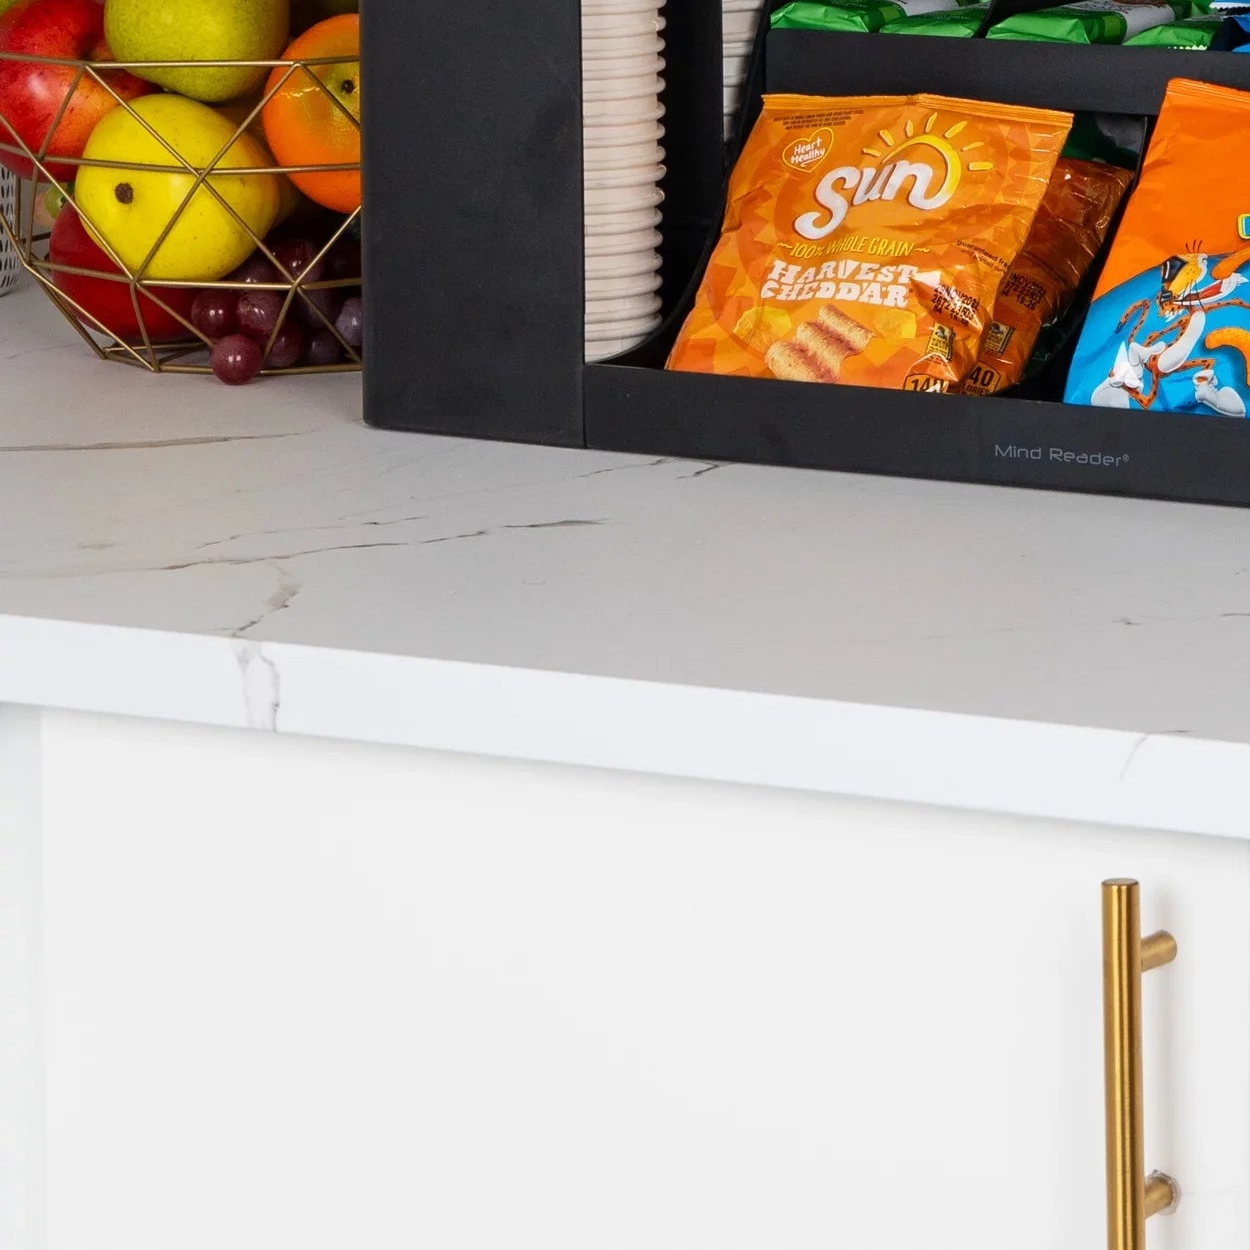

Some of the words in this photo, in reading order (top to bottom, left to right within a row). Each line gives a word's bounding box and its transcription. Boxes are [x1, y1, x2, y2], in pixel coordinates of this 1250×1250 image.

[790, 148, 826, 164] Healthy
[793, 136, 823, 155] Heart
[794, 156, 960, 240] Sun
[790, 242, 824, 259] 100%
[826, 236, 868, 255] WHOLE
[868, 237, 915, 257] GRAIN
[957, 240, 998, 262] guaranteed
[767, 259, 919, 285] HARVEST
[760, 280, 908, 308] CHEDDAR
[994, 444, 1042, 460] Mind
